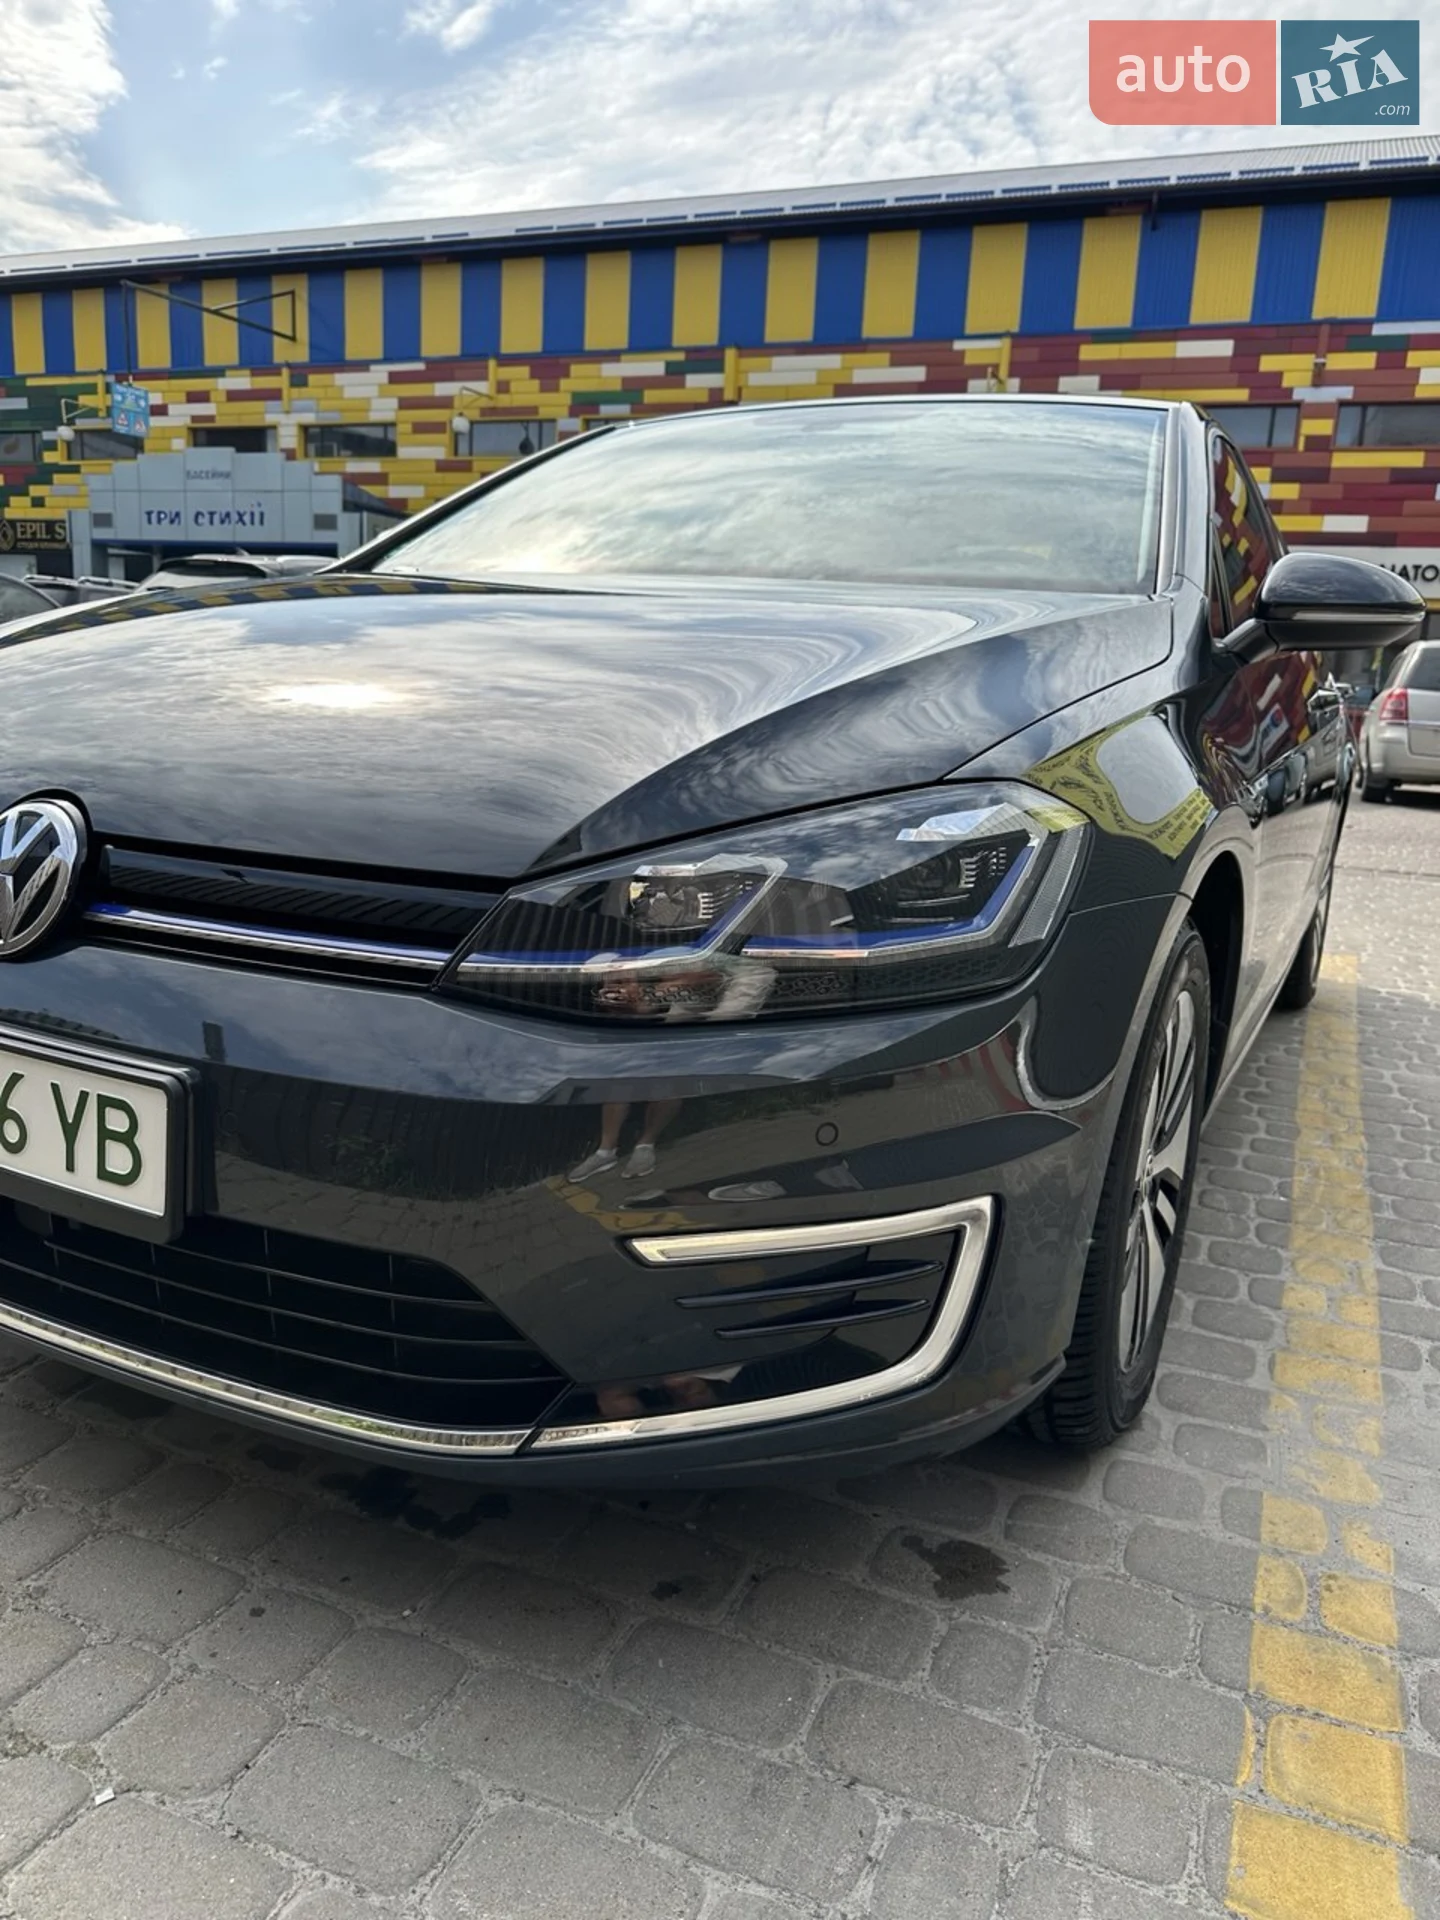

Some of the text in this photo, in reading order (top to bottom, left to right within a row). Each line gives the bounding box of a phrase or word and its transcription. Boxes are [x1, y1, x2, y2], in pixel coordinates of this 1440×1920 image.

[144, 501, 265, 527] ТРИ СТИХІЇ
[16, 521, 51, 540] EPIL
[0, 1071, 142, 1187] 6 YB
